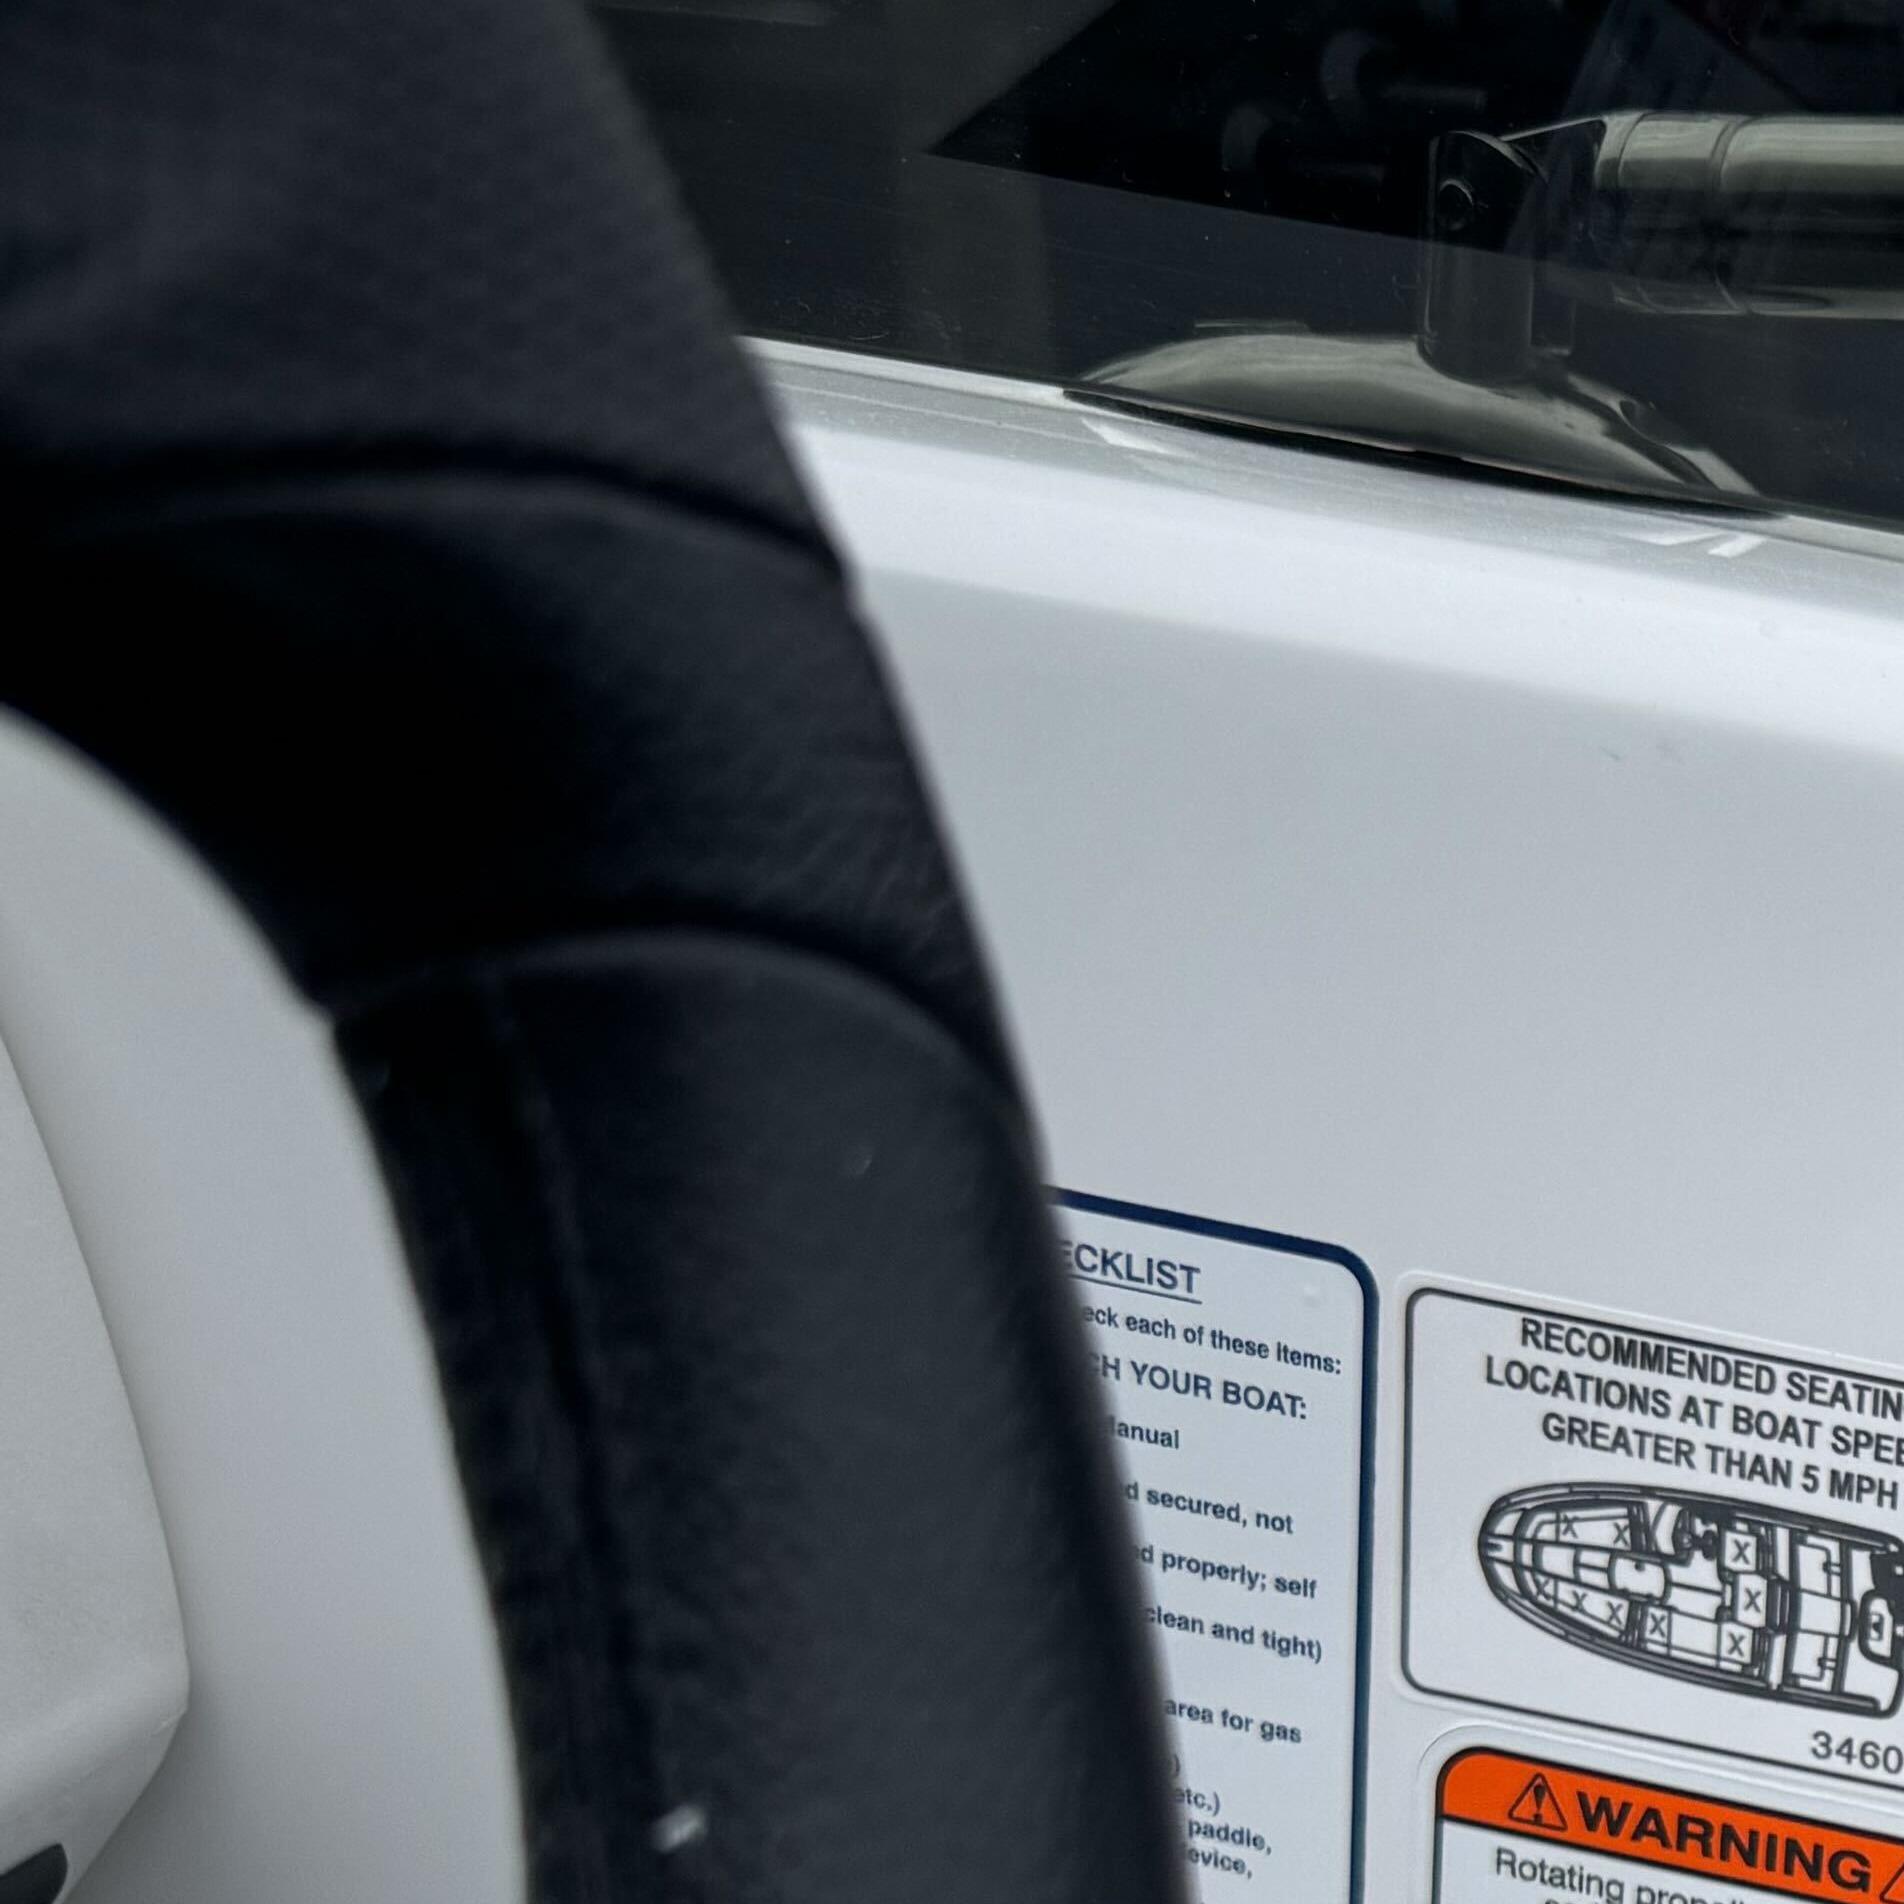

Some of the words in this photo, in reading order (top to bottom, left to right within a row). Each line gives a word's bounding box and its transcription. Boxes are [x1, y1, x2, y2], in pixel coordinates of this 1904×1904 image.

[1085, 1303, 1118, 1329] eck
[1126, 1312, 1175, 1340] each
[1183, 1323, 1204, 1346] of
[1210, 1329, 1269, 1360] these
[1521, 1318, 1776, 1397] RECOMMENDED
[1130, 1361, 1211, 1399] YOUR
[1222, 1380, 1306, 1419] BOAT:
[1486, 1353, 1671, 1420] LOCATIONS
[1679, 1393, 1723, 1430] AT
[1732, 1404, 1818, 1451] BOAT
[1541, 1410, 1695, 1470] GREATER
[1705, 1444, 1791, 1489] THAN
[1802, 1464, 1819, 1495] 5
[1828, 1469, 1898, 1510] MPH
[1146, 1485, 1247, 1527] secured,
[1256, 1509, 1293, 1534] not
[1161, 1549, 1266, 1593] properly;
[1274, 1572, 1317, 1599] self
[1212, 1617, 1254, 1644] and
[1261, 1628, 1322, 1664] tight)
[1164, 1698, 1213, 1723] area
[1221, 1708, 1254, 1733] for
[1260, 1720, 1301, 1747] gas
[1187, 1843, 1252, 1879] evice,
[1188, 1817, 1272, 1855] paddle,
[1576, 1790, 1872, 1893] WARNING
